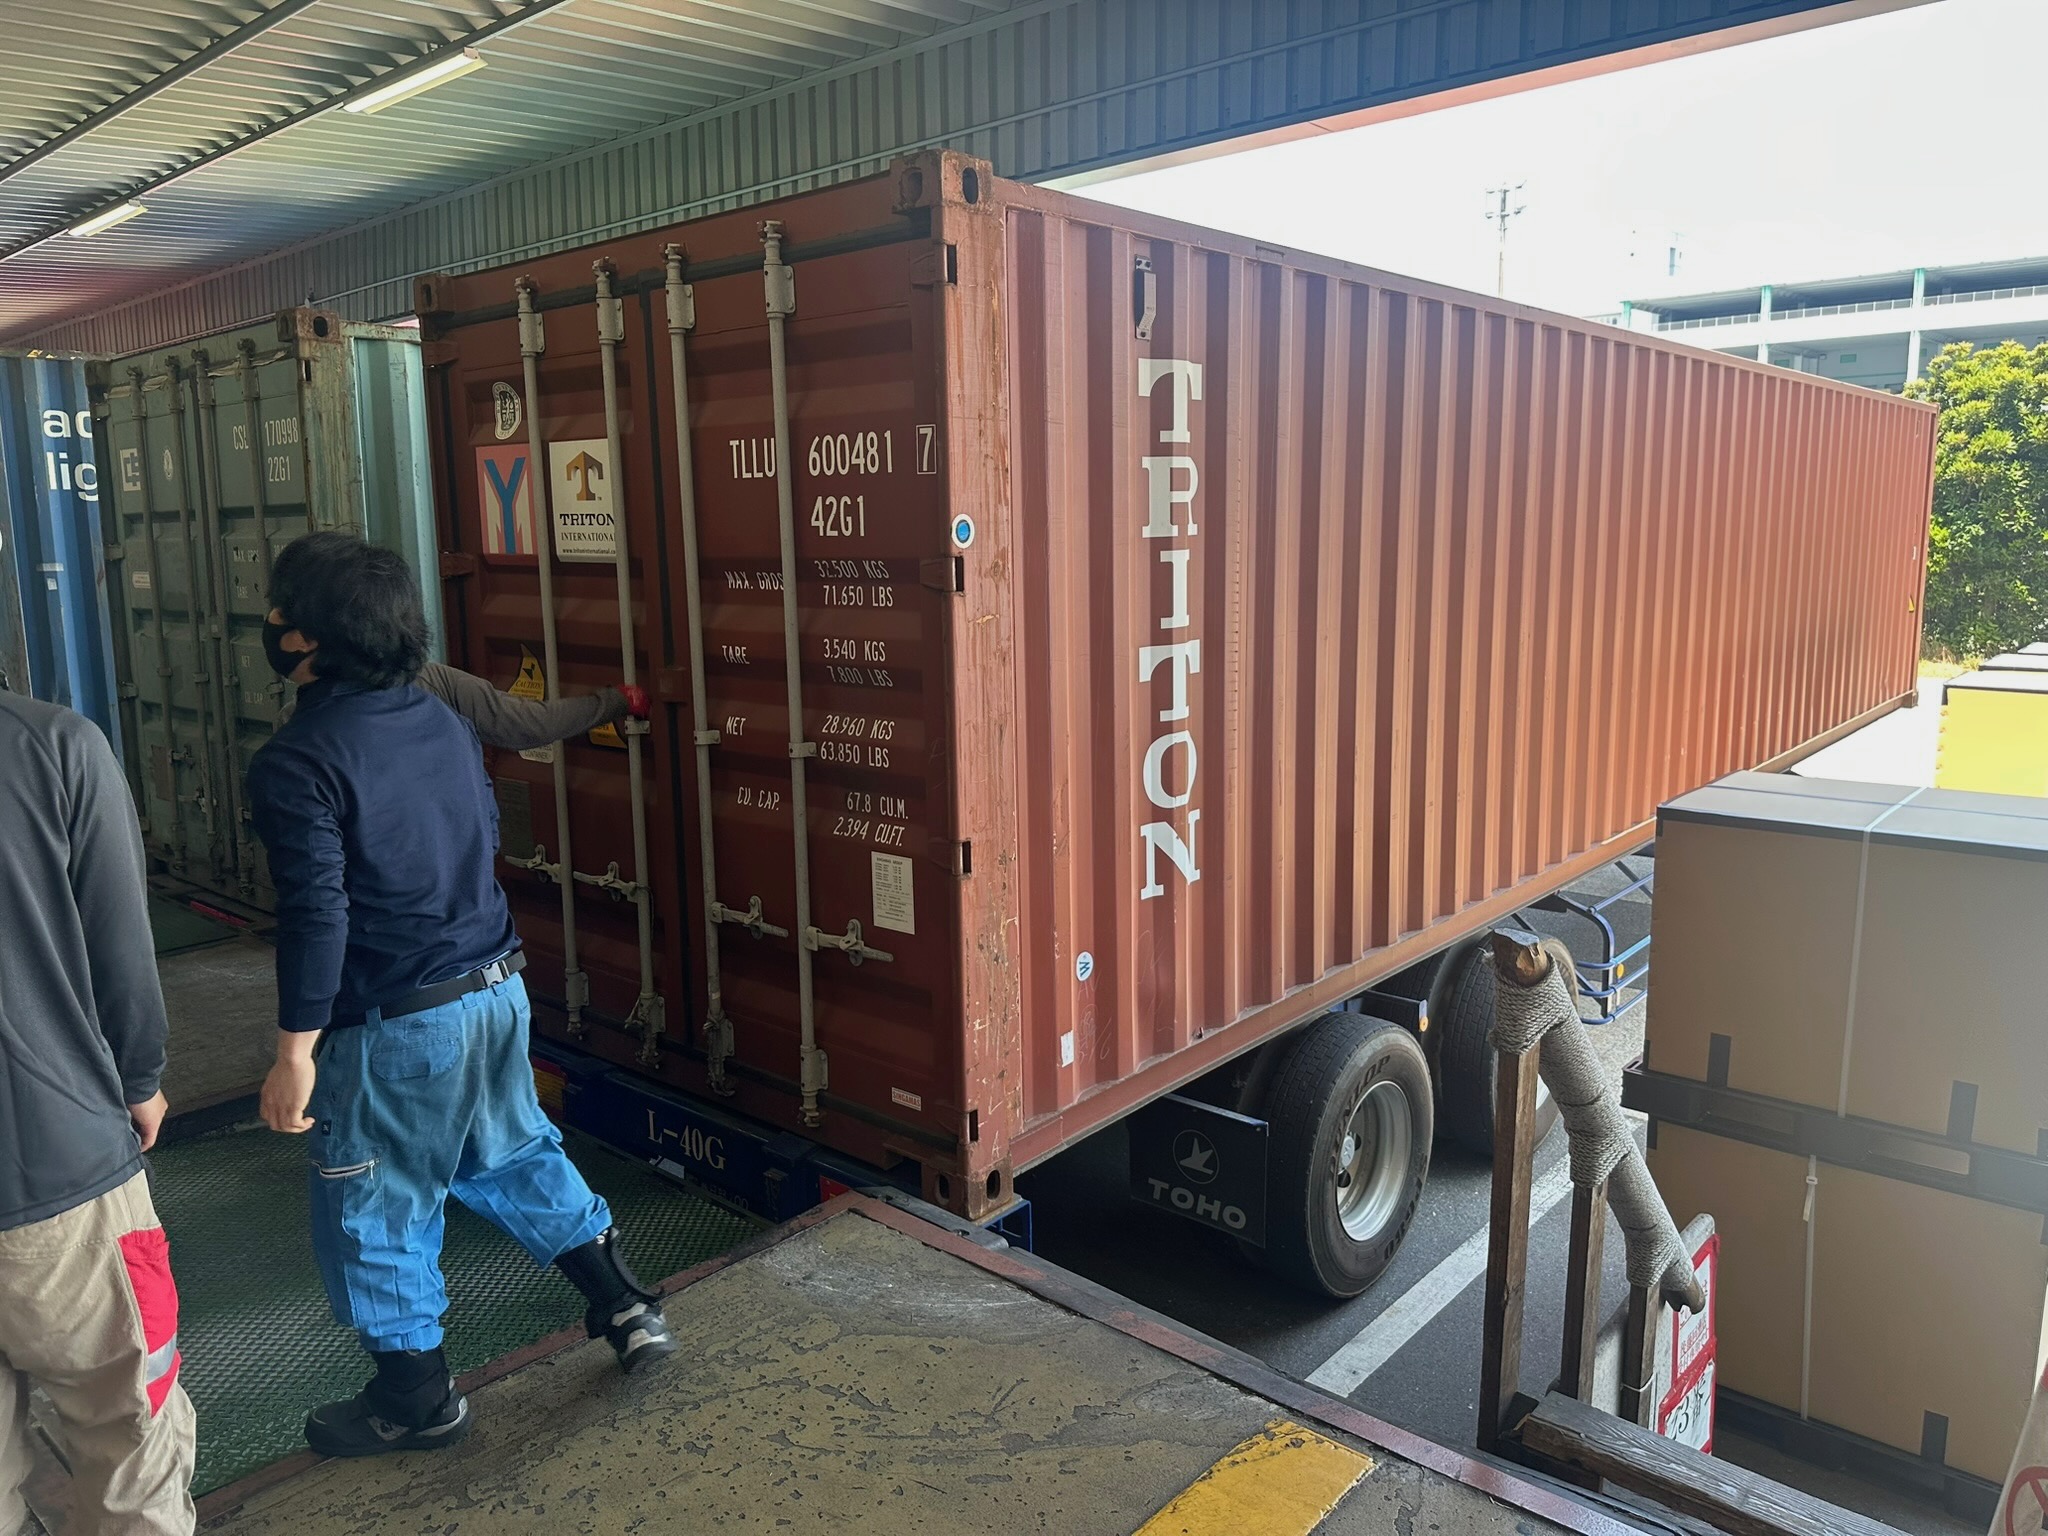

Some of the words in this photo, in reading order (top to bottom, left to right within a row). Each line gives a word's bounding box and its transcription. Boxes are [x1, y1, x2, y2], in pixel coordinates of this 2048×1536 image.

[264, 416, 299, 447] 170998
[729, 437, 776, 479] TLLU
[808, 429, 893, 477] 600481
[46, 451, 99, 502] lig
[267, 455, 292, 482] 22G1
[559, 513, 615, 526] TRITON
[810, 495, 866, 537] 42G1
[561, 532, 616, 542] INTERNATIONA
[724, 571, 754, 590] MAX.
[864, 559, 890, 579] KGS
[872, 585, 894, 607] LBS
[1137, 357, 1203, 900] TRITON
[721, 645, 750, 665] TARE
[864, 640, 886, 662] KGS
[868, 668, 894, 688] LBS
[726, 715, 747, 736] NET
[869, 719, 895, 741] KGS
[868, 744, 890, 769] LBS
[737, 786, 752, 807] CU.
[757, 790, 781, 811] CAP.
[846, 791, 872, 814] 67.8
[880, 795, 909, 820] CU.M.
[646, 1108, 727, 1170] L-40G
[1147, 1177, 1248, 1231] TOHO
